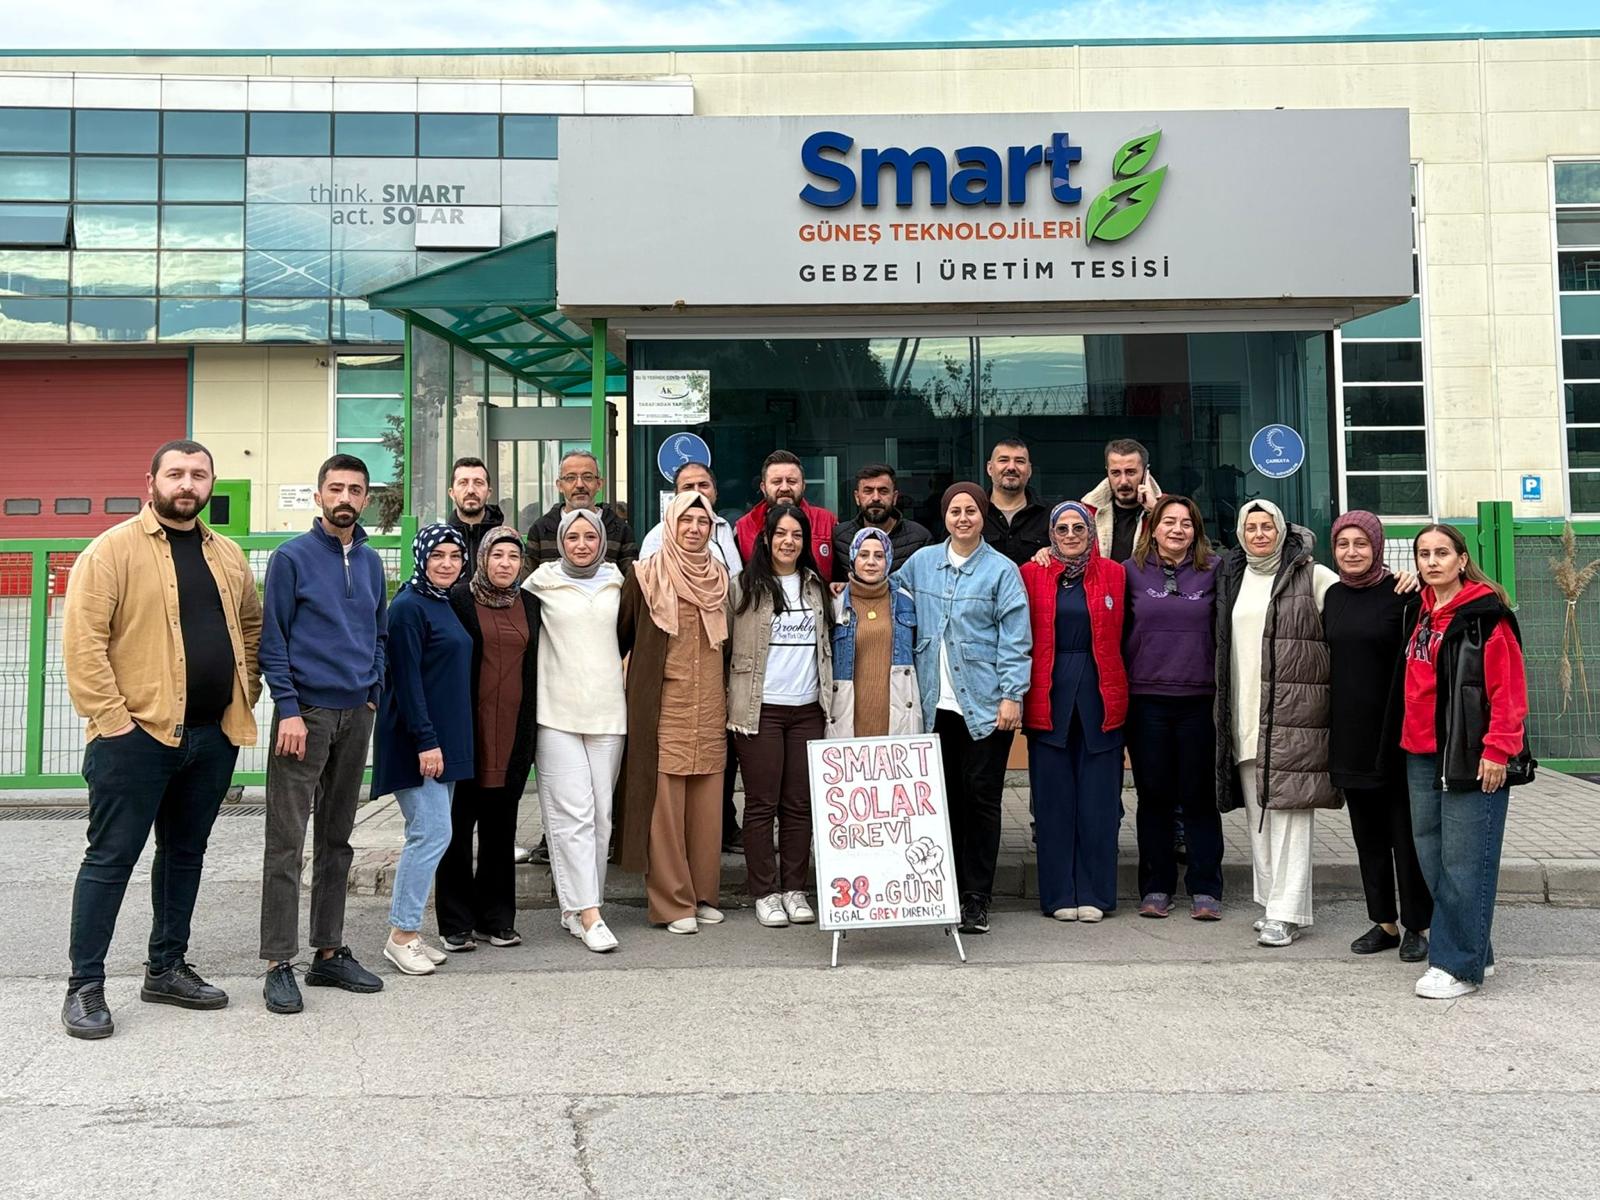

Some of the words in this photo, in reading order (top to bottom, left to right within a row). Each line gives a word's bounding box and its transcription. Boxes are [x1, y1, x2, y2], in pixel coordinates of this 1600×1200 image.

[799, 130, 1082, 208] Smart
[309, 183, 374, 203] think.
[382, 184, 466, 204] SMART
[332, 207, 374, 225] act.
[382, 206, 465, 225] SOLAR
[799, 220, 882, 245] GÜNEŞ
[889, 217, 1082, 242] TEKNOLOJİLERİ
[799, 263, 898, 282] GEBZE
[939, 257, 1054, 281] ÜRETİM
[1071, 255, 1170, 279] TESİSİ
[1525, 479, 1538, 492] P
[822, 741, 933, 785] SMART
[825, 780, 937, 826] SOLAR
[829, 816, 913, 850] GREVİ
[869, 906, 899, 921] GREV
